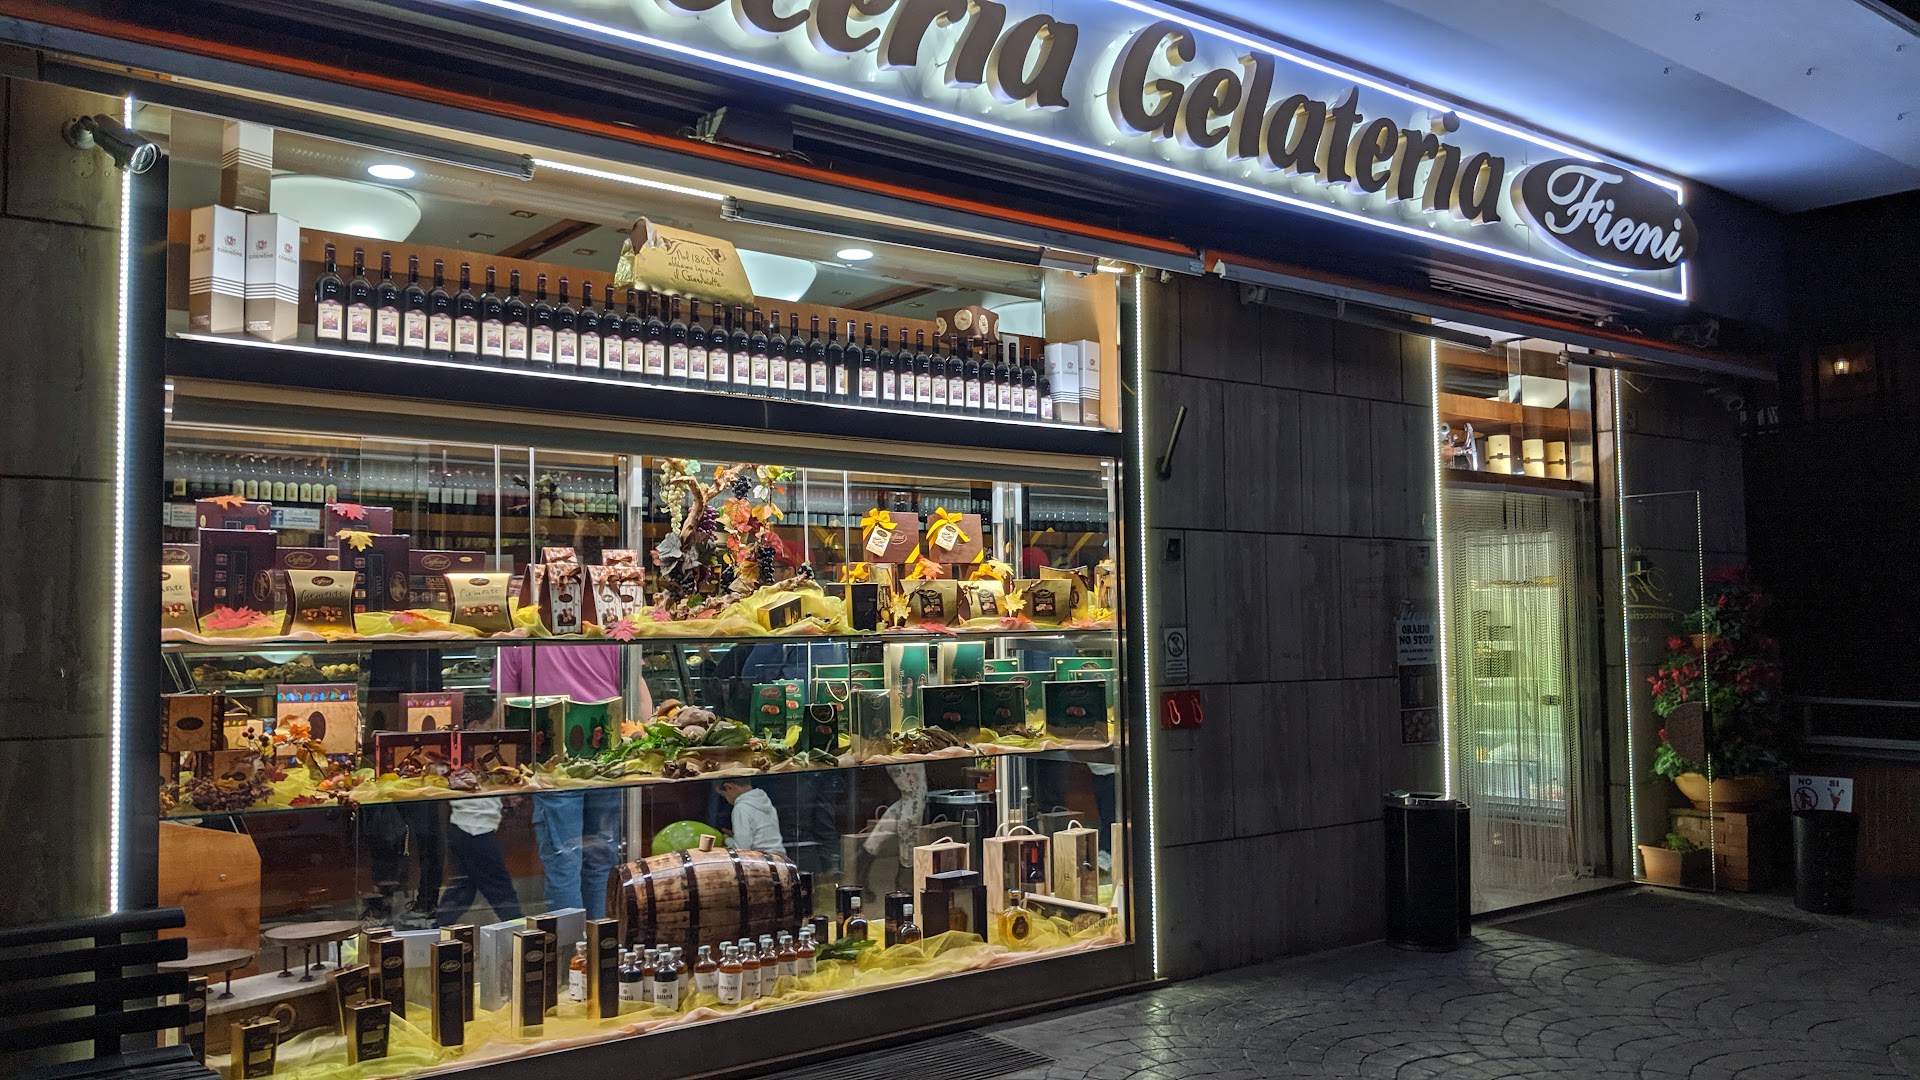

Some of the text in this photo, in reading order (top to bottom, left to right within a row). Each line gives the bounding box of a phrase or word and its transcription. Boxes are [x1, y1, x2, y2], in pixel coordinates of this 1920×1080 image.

[1108, 20, 1505, 223] Gelateria
[1546, 164, 1684, 264] Fieni
[691, 254, 711, 266] 1865
[1401, 624, 1430, 635] ORARIO
[1399, 635, 1434, 645] NO STOP
[1798, 777, 1812, 786] NO
[1828, 779, 1840, 787] SI
